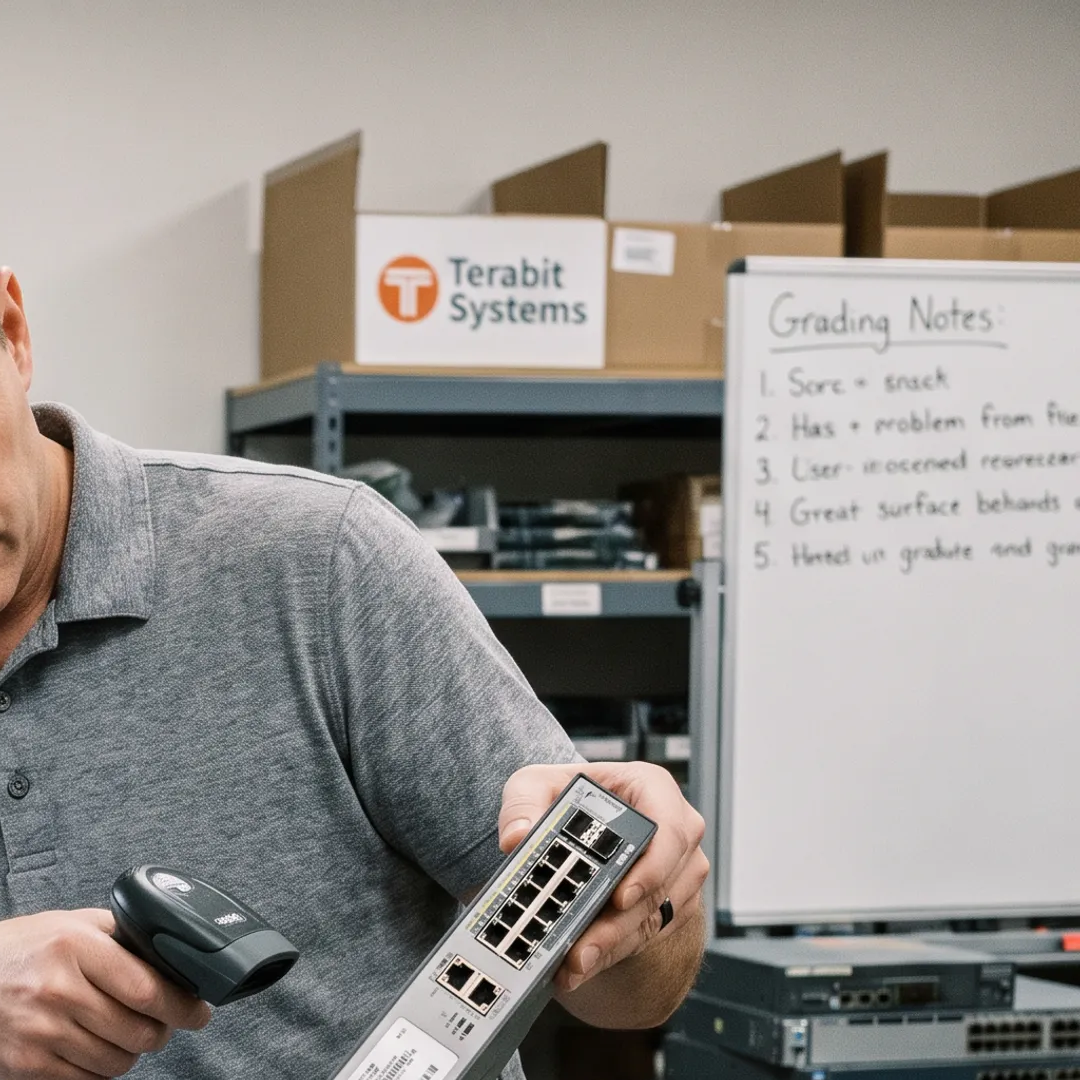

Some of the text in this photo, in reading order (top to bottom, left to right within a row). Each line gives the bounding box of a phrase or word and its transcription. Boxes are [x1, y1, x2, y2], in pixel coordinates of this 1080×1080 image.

[449, 257, 565, 289] Terabit
[449, 293, 588, 330] Systems
[769, 291, 892, 355] Grading
[791, 412, 837, 441] Has
[981, 401, 1034, 429] from
[790, 496, 861, 527] Great
[877, 489, 961, 521] surface
